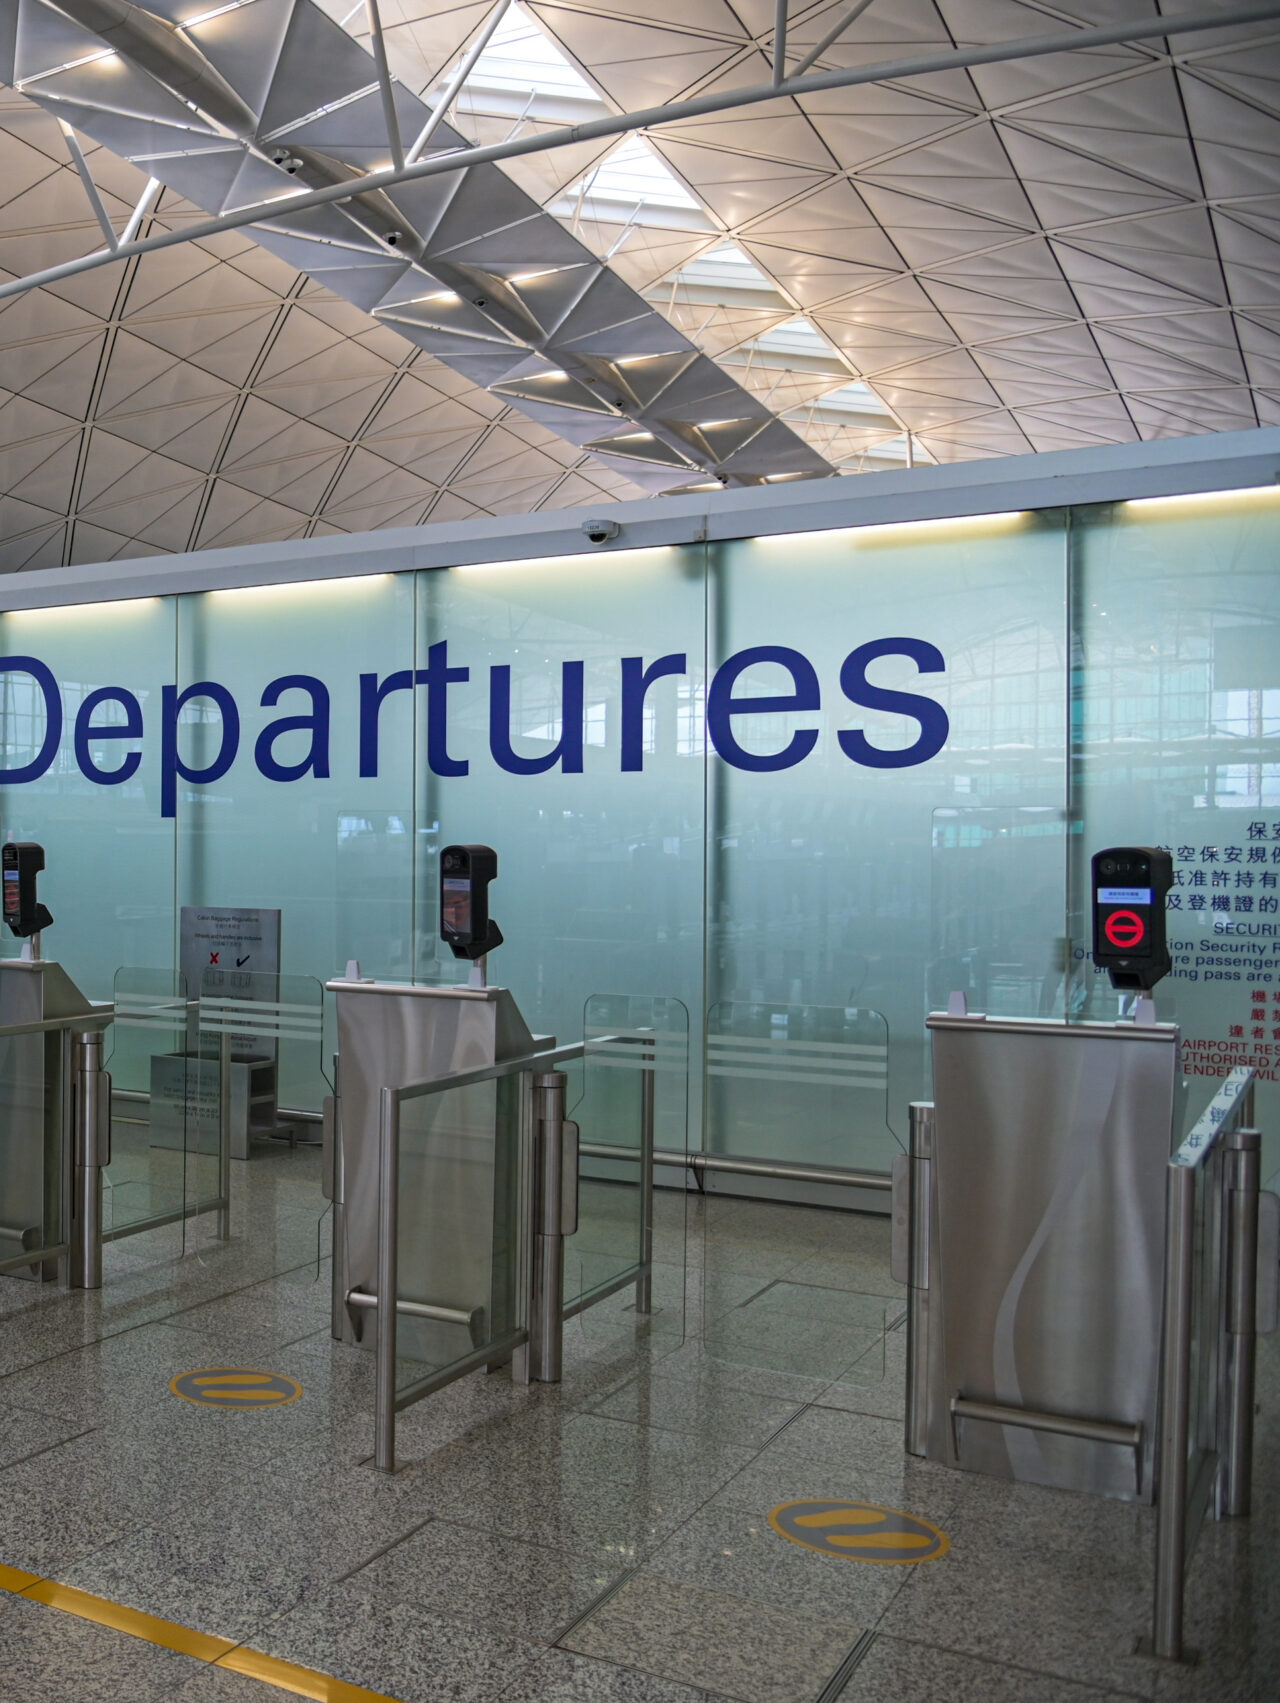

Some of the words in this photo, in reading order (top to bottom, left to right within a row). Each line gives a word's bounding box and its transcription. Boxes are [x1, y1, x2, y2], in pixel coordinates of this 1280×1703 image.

[1164, 893, 1279, 914] 及登機證的
[1201, 940, 1266, 956] Security
[1203, 969, 1241, 982] pass
[1246, 971, 1272, 982] are
[1181, 1039, 1249, 1054] AIRPORT
